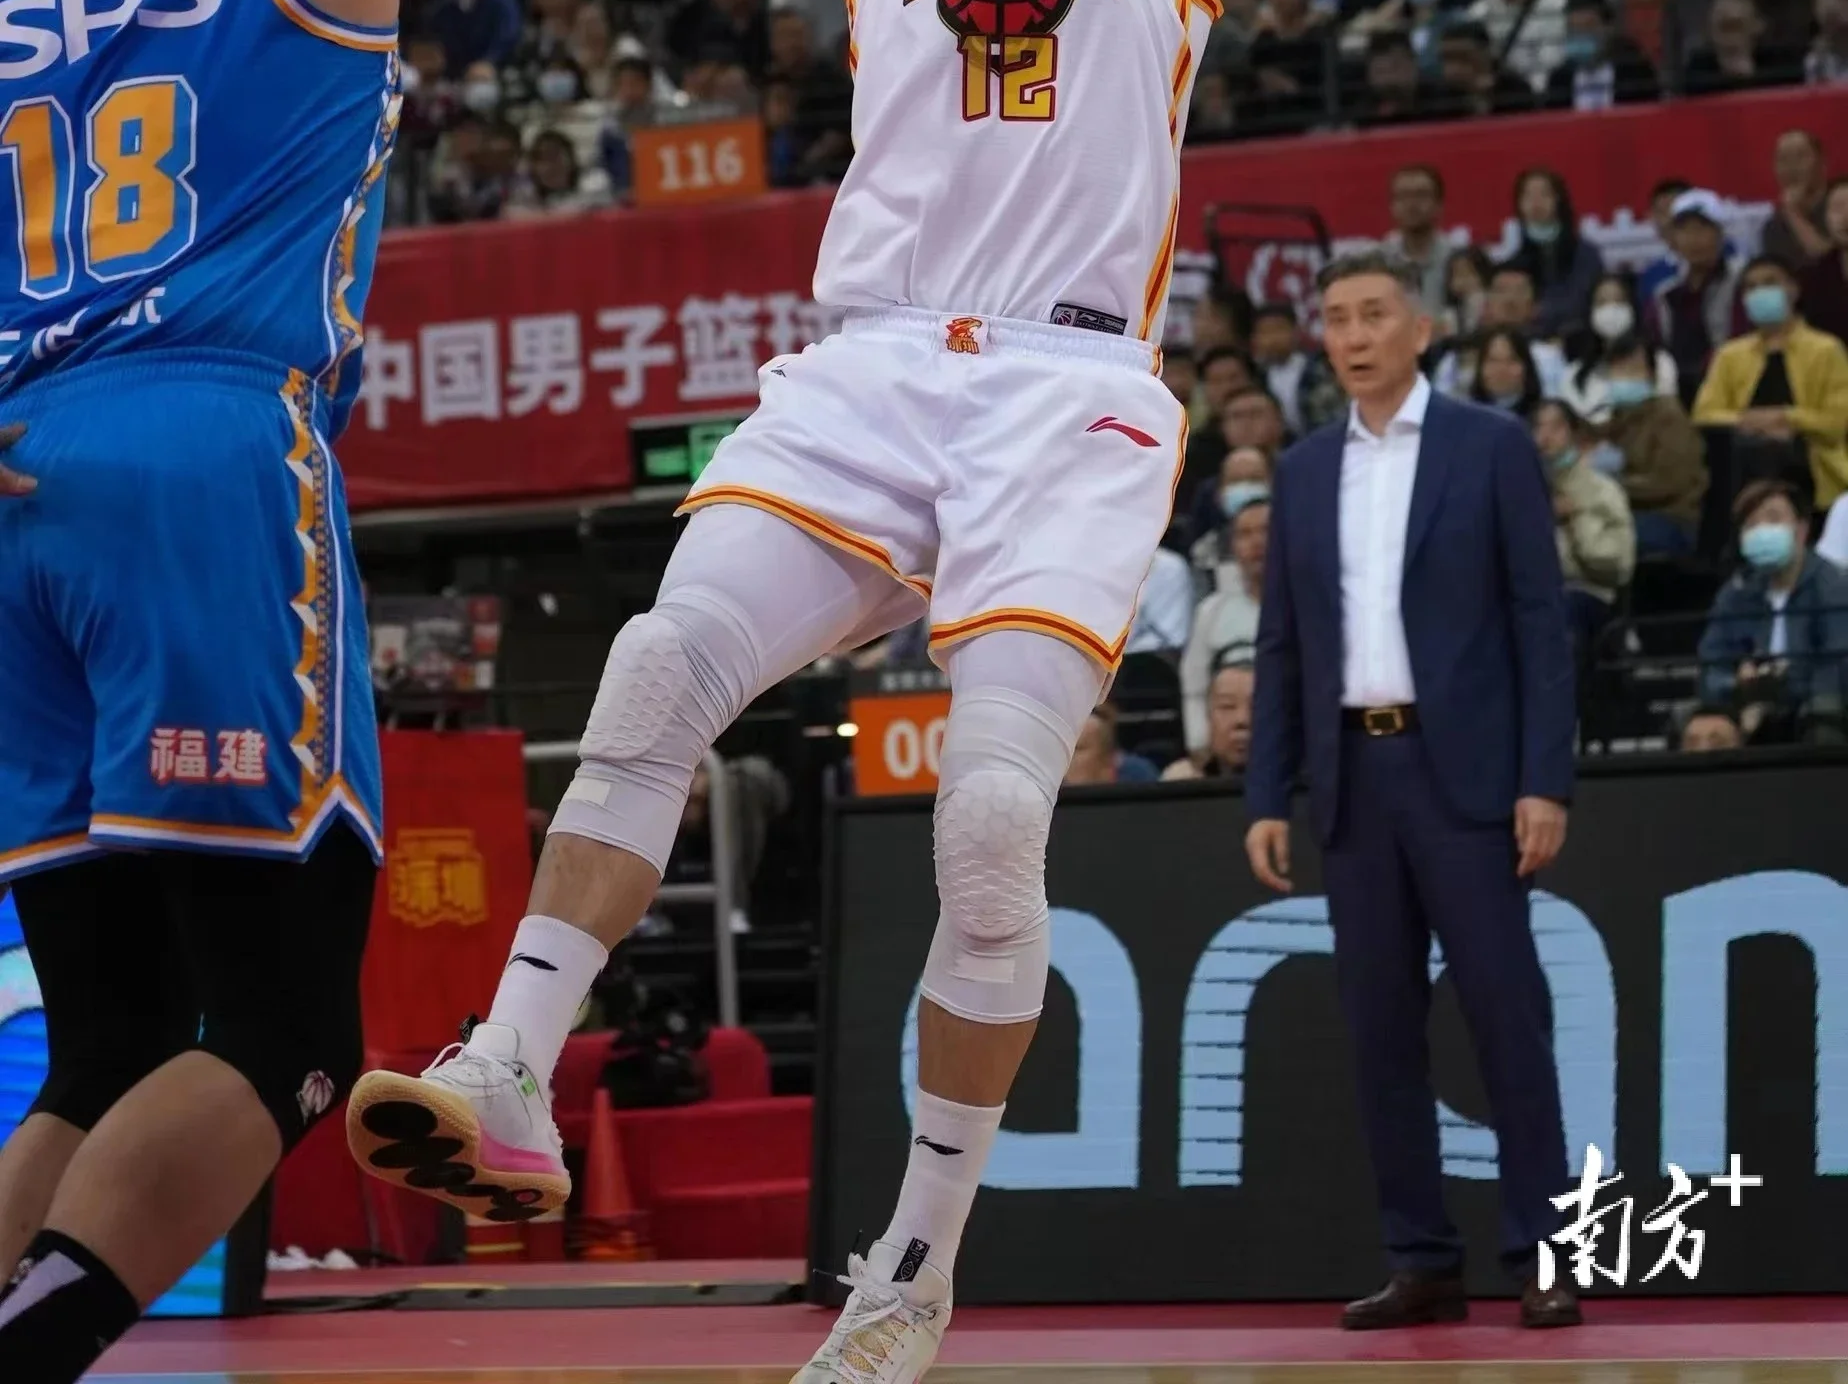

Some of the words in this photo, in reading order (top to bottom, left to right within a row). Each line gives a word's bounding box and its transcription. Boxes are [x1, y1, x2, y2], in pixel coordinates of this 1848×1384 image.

[957, 33, 1058, 122] 12
[0, 74, 198, 301] 18
[656, 136, 746, 193] 116
[149, 726, 268, 785] 福建
